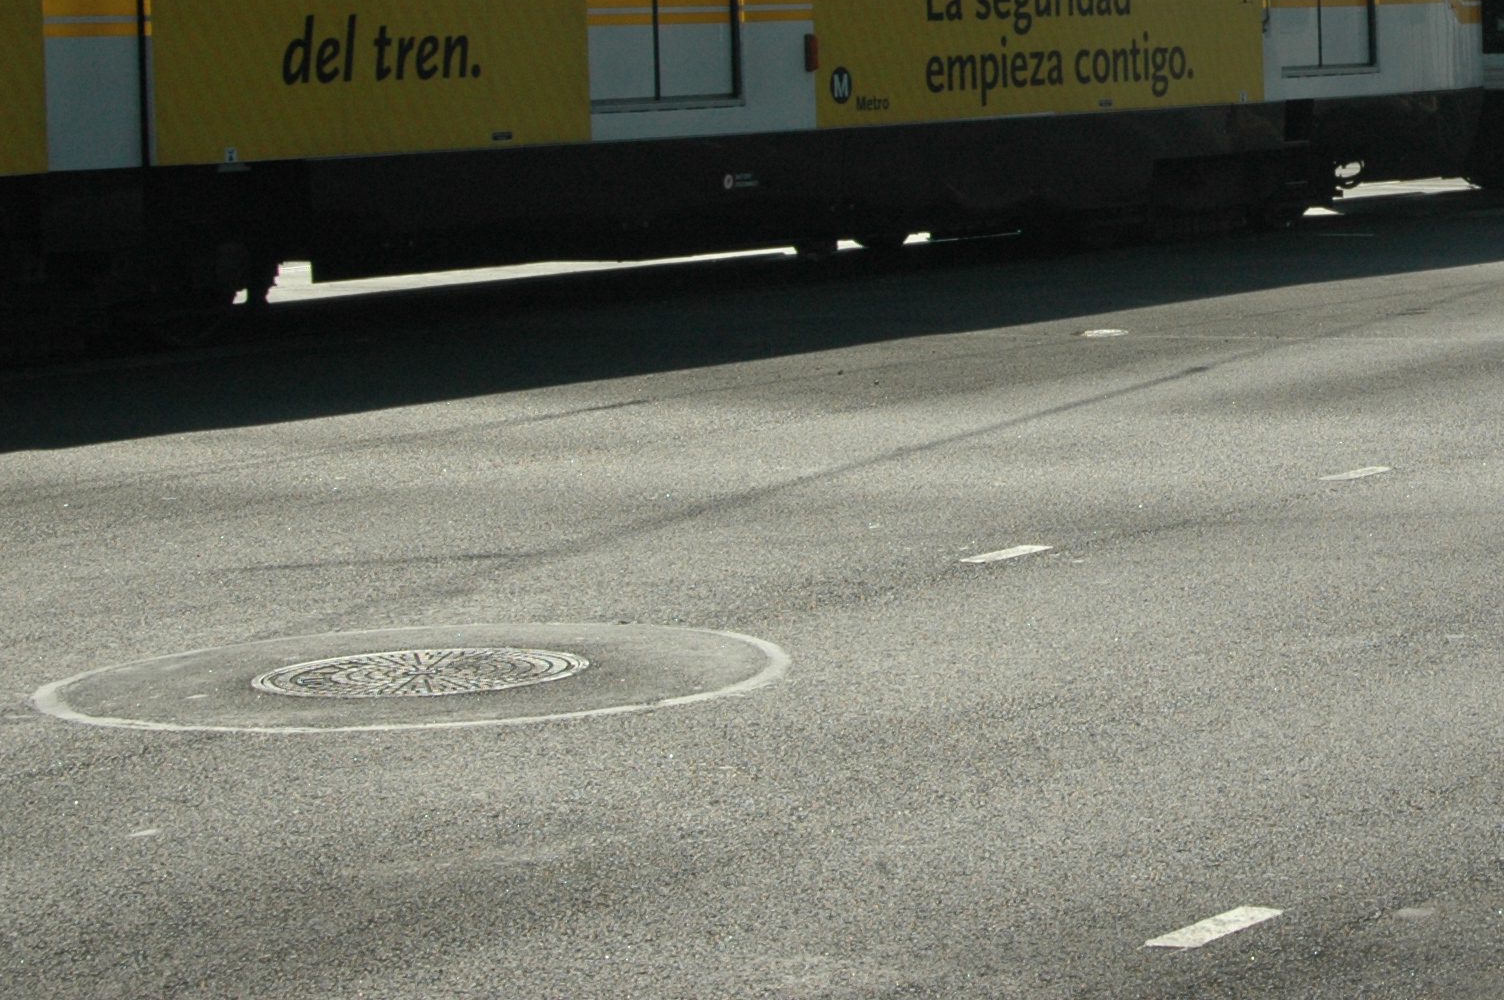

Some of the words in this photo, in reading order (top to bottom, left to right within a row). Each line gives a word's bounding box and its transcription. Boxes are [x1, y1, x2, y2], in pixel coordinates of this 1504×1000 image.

[282, 13, 357, 86] del
[372, 24, 482, 82] tren.
[926, 35, 1064, 107] empieza
[1074, 31, 1194, 97] contigo.
[856, 95, 890, 111] Metro
